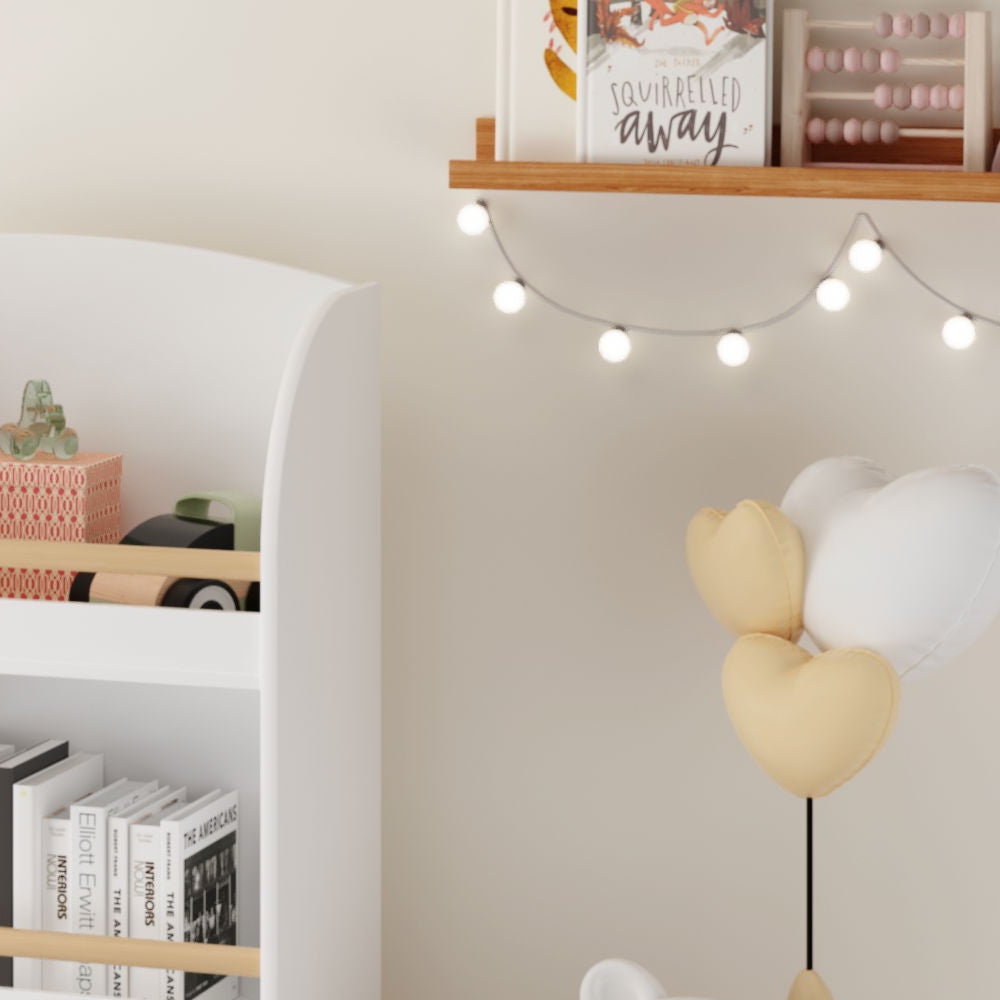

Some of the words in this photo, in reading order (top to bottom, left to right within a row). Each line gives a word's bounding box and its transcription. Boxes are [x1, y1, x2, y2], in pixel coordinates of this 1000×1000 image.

[610, 73, 742, 116] SQUIRRELLED
[614, 109, 739, 166] away
[79, 812, 96, 865] Elliott
[183, 828, 197, 849] THE
[199, 803, 238, 840] AMERICANS
[57, 855, 67, 920] INTERIORS
[79, 873, 96, 929] Erwitt
[113, 889, 121, 913] THE
[144, 861, 155, 926] INTERIORS
[166, 892, 174, 917] THE
